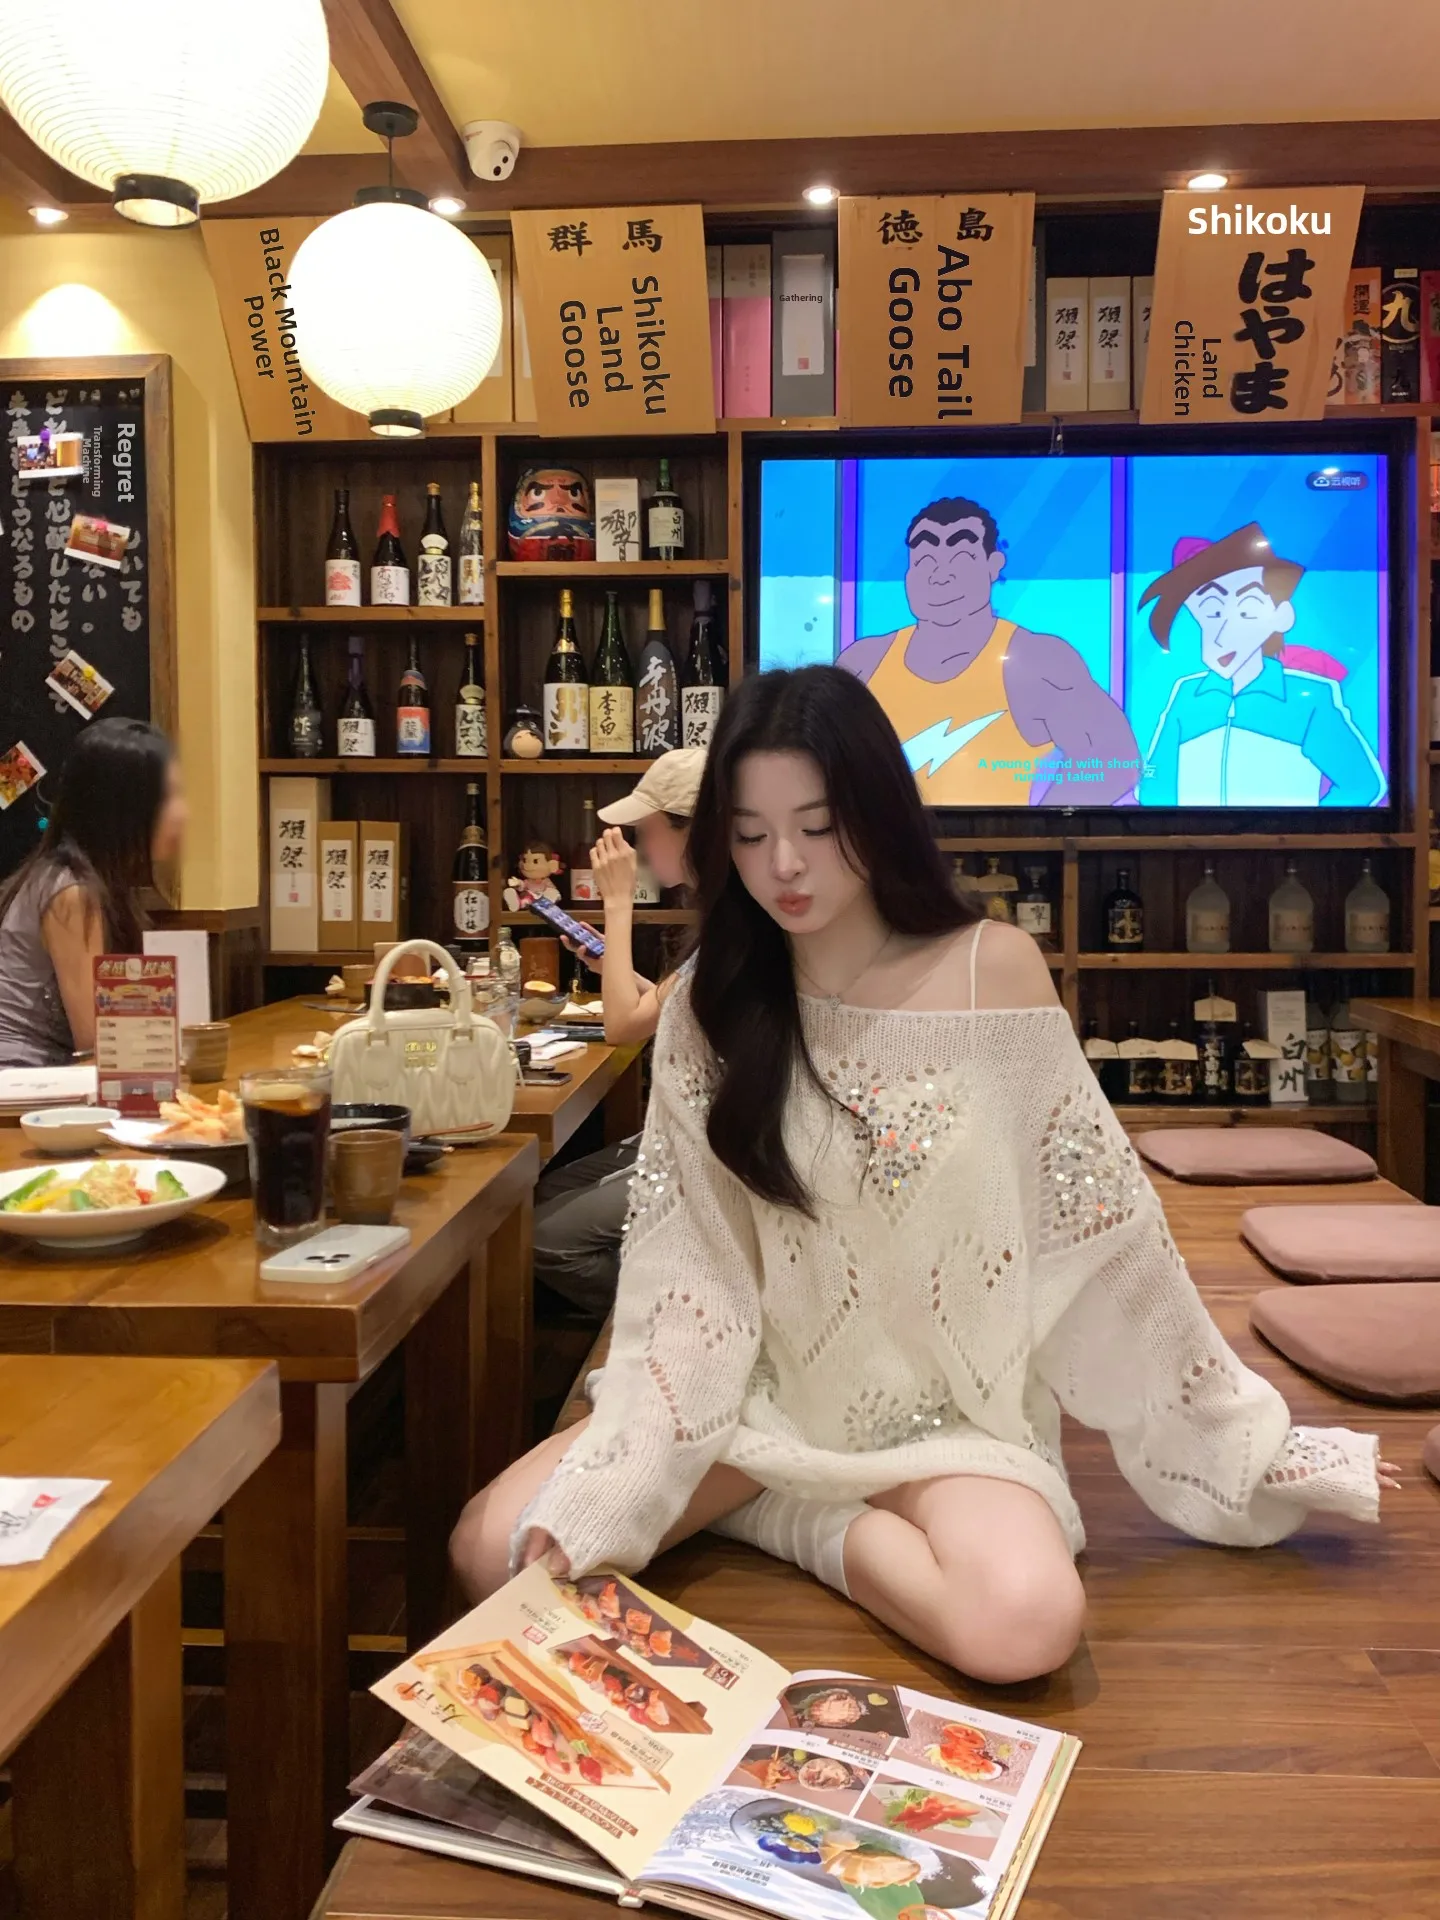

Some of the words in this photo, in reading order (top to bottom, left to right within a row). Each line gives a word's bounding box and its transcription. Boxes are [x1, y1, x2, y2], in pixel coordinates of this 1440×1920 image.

[547, 219, 663, 256] 群馬
[877, 208, 995, 246] 徳島
[1229, 249, 1316, 414] はやま
[597, 690, 617, 736] 李白
